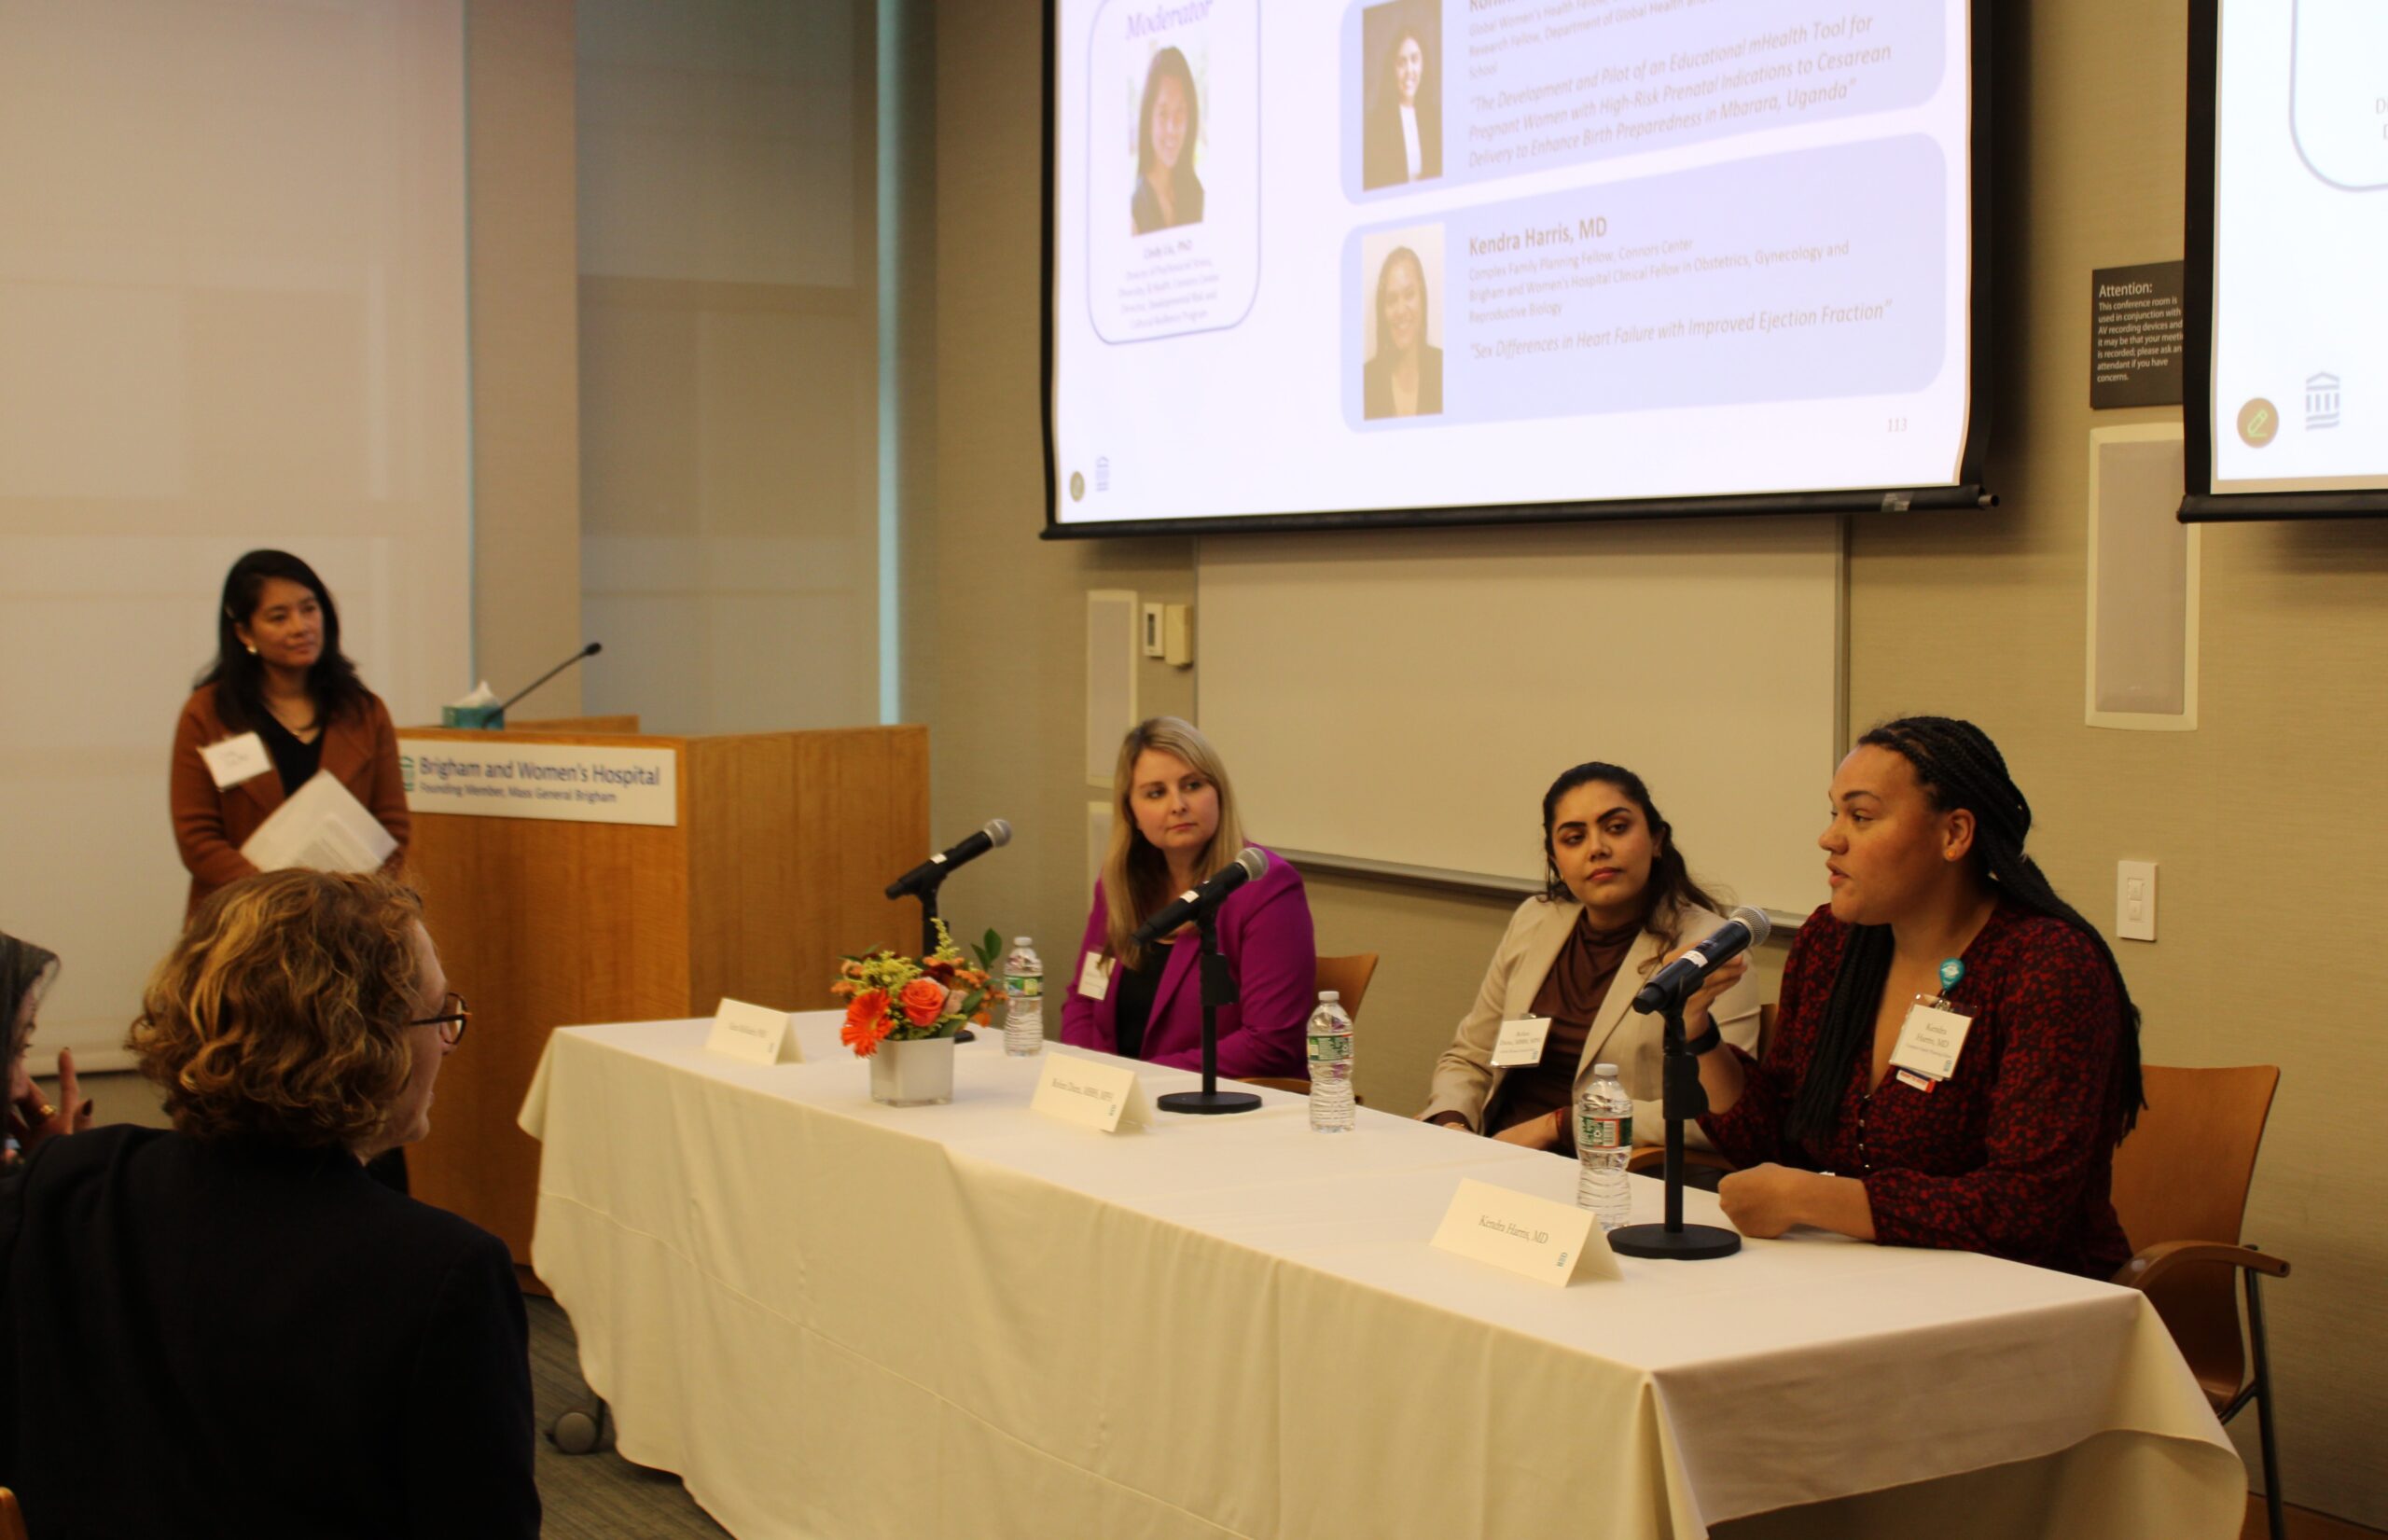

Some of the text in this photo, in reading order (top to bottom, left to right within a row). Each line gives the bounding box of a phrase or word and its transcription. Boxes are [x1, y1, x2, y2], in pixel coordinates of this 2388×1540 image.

[1125, 0, 1213, 40] Moderator
[1497, 78, 1574, 109] Development
[1576, 72, 1598, 91] and
[1601, 63, 1629, 85] Pilot
[1633, 59, 1647, 82] of
[1649, 59, 1666, 76] an
[1669, 38, 1746, 73] Educational
[1748, 25, 1808, 54] mHealth
[1814, 14, 1846, 40] Tool
[1849, 13, 1874, 39] for
[1469, 44, 1893, 143] Pregnant Women with High-Risk Prenatal Indications to Cesarean
[1469, 146, 1514, 169] Delivery
[1516, 143, 1529, 159] to
[1531, 133, 1580, 156] Enhance
[1582, 125, 1613, 147] Birth
[1616, 107, 1702, 141] Preparedness
[1704, 105, 1717, 122] in
[1719, 93, 1783, 120] Mbarara,
[1469, 215, 1608, 257] Kendra Harris, MD
[1508, 259, 1538, 275] Family
[1539, 254, 1579, 270] Planning
[1617, 243, 1659, 261] Connors
[1660, 237, 1694, 256] Center
[1469, 239, 1850, 303] Brigham and Women's Hospital Clinical Fellow in Obstetrics, Gynecology and
[2099, 282, 2153, 298] Attention:
[2099, 295, 2177, 311] This conference room is
[1469, 299, 1563, 325] Reproductive Biology
[2098, 307, 2182, 323] used in conjunction with
[1494, 336, 1560, 359] Differences
[1561, 334, 1574, 349] in
[1576, 326, 1611, 348] Heart
[1613, 322, 1655, 344] Failure
[1656, 318, 1686, 339] with
[1687, 312, 1755, 340] Improved
[1758, 308, 1817, 334] Ejection
[2098, 318, 2184, 335] AV recording devices and
[2103, 338, 2118, 348] may
[2118, 336, 2129, 345] be
[2130, 334, 2144, 344] that
[2145, 334, 2161, 345] your
[2137, 345, 2159, 357] please
[2160, 343, 2172, 354] ask
[2173, 344, 2182, 353] an
[2097, 360, 2129, 370] attendant
[2136, 359, 2150, 370] you
[2150, 356, 2168, 367] have
[2097, 372, 2129, 382] concerns.
[1887, 417, 1909, 433] 113
[419, 756, 660, 788] Brigham and Women's Hospital
[419, 782, 463, 798] Founding
[508, 785, 533, 799] Mass
[535, 787, 572, 801] General
[576, 788, 617, 805] Brigham
[1478, 1214, 1549, 1245] Kendra Harris, MD
